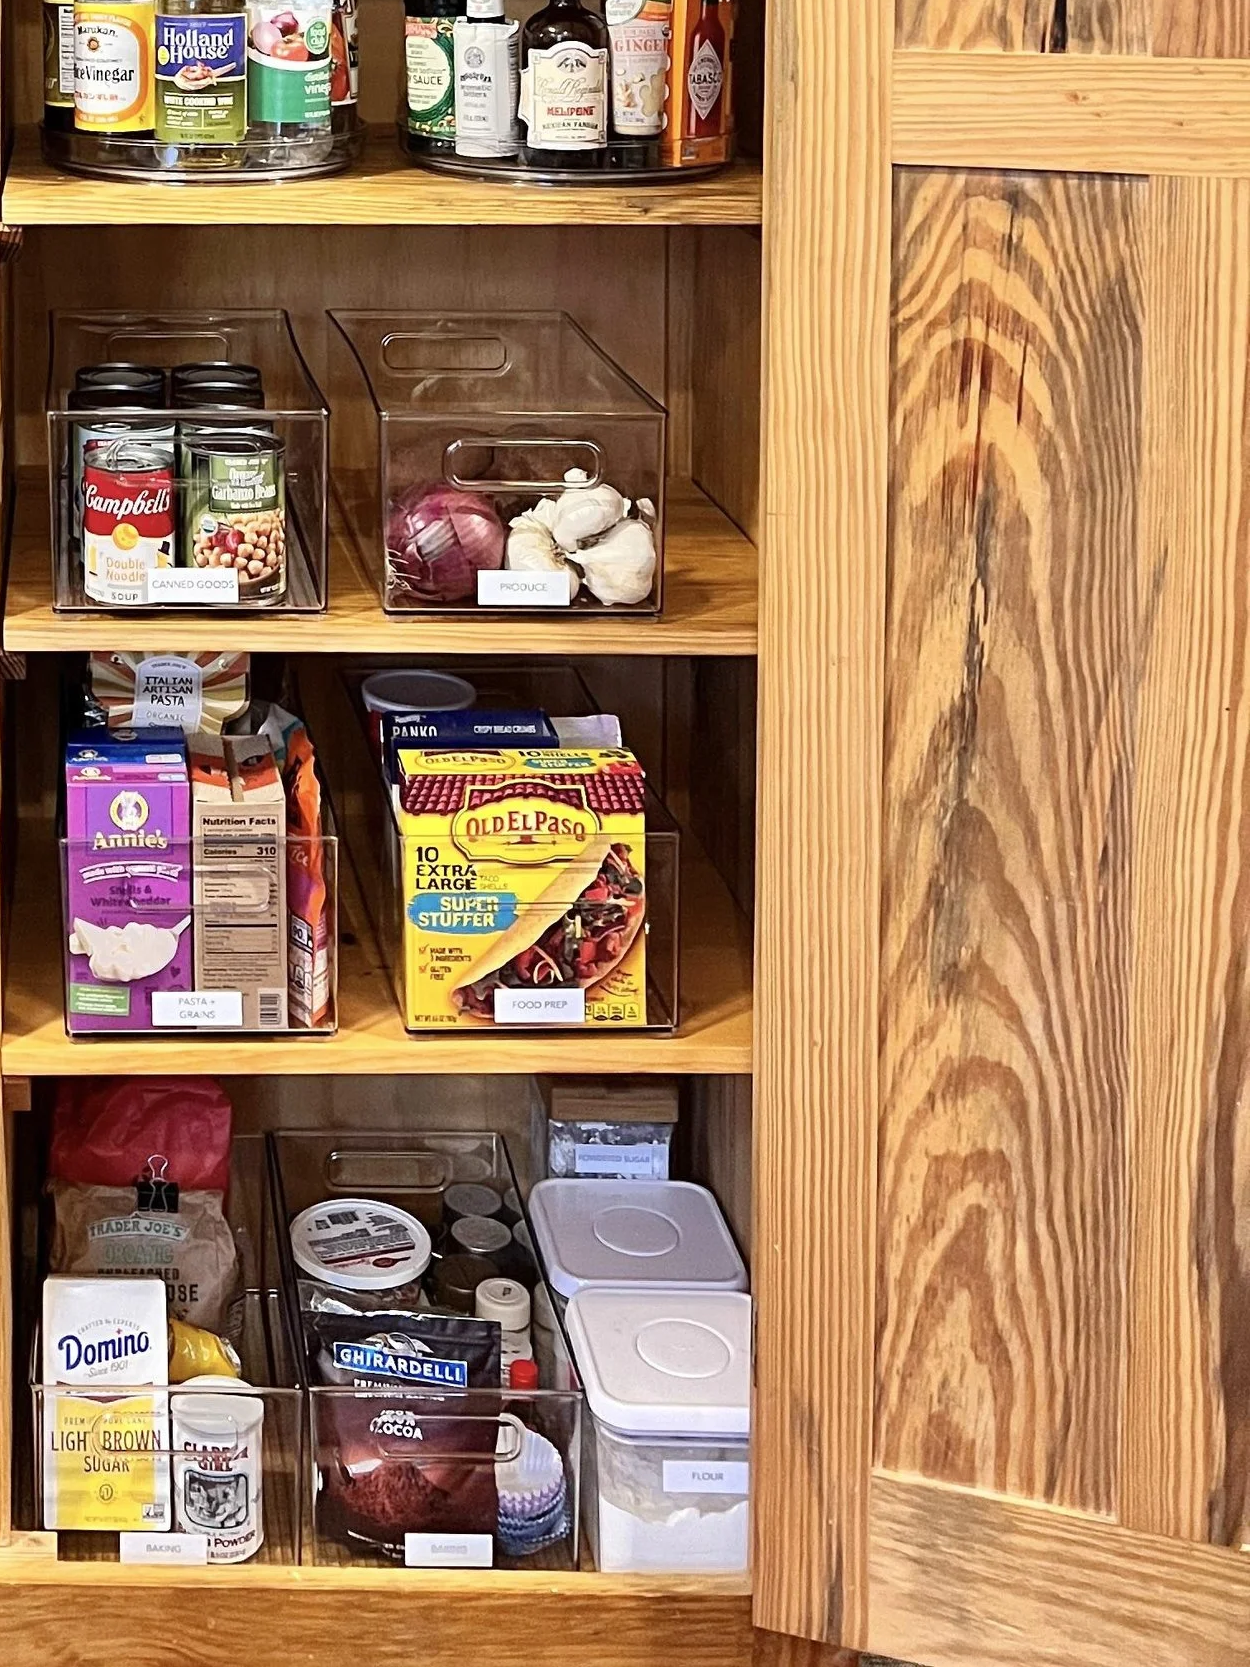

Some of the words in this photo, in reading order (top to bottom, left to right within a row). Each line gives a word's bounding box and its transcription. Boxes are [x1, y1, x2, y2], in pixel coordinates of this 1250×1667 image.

[76, 25, 117, 37] Marukan
[163, 27, 234, 47] Holland
[170, 45, 229, 64] House
[85, 65, 135, 82] Vinegar
[689, 72, 723, 85] TABASCO
[415, 76, 444, 85] SAUCE
[184, 96, 216, 106] COOKING
[546, 105, 596, 117] MELIPONE
[212, 485, 254, 500] Garbanzo
[255, 484, 276, 499] Beans
[83, 481, 170, 521] Campbell's
[105, 556, 146, 570] Double
[105, 570, 146, 582] Noodle
[152, 580, 195, 589] CANNED
[196, 580, 235, 589] GOODS
[499, 583, 548, 592] PRODUCE
[111, 591, 139, 601] SOUP
[144, 676, 193, 685] ITALIAN
[142, 686, 193, 695] ARTISAN
[150, 694, 185, 707] PASTA
[146, 710, 186, 722] ORGANIC
[392, 725, 438, 738] PANKO
[425, 756, 450, 765] OLD
[454, 755, 467, 764] EL
[202, 817, 246, 826] Nutrition
[248, 817, 276, 826] Facts
[466, 816, 505, 841] OLD
[507, 811, 533, 832] EL
[92, 829, 169, 851] Annie's
[203, 847, 237, 856] Calories
[256, 846, 276, 855] 310
[416, 846, 439, 863] 10
[416, 864, 477, 877] EXTRA
[415, 878, 477, 891] LARGE
[480, 875, 499, 883] TACO
[90, 895, 124, 908] White
[440, 896, 499, 912] SUPER
[418, 912, 495, 928] STUFFER
[429, 973, 444, 981] FREE
[178, 997, 206, 1006] PASTA
[512, 1000, 542, 1009] FOOD
[544, 1000, 568, 1009] PREP
[179, 1010, 216, 1019] GRAINS
[623, 1155, 651, 1163] SUGAR
[90, 1220, 141, 1237] TRADER
[143, 1220, 184, 1238] JOE'S
[104, 1243, 175, 1265] ORGANIC
[77, 1319, 104, 1336] CRAFTED
[112, 1317, 141, 1332] EXPERTS
[57, 1330, 150, 1371] Domino
[109, 1360, 129, 1375] 1901
[339, 1346, 465, 1384] GHIRARDELLI
[103, 1430, 161, 1451] BROWN
[83, 1455, 130, 1473] SUGAR
[691, 1472, 725, 1482] FLOUR
[213, 1529, 256, 1548] POWDER
[145, 1544, 182, 1553] BAKING
